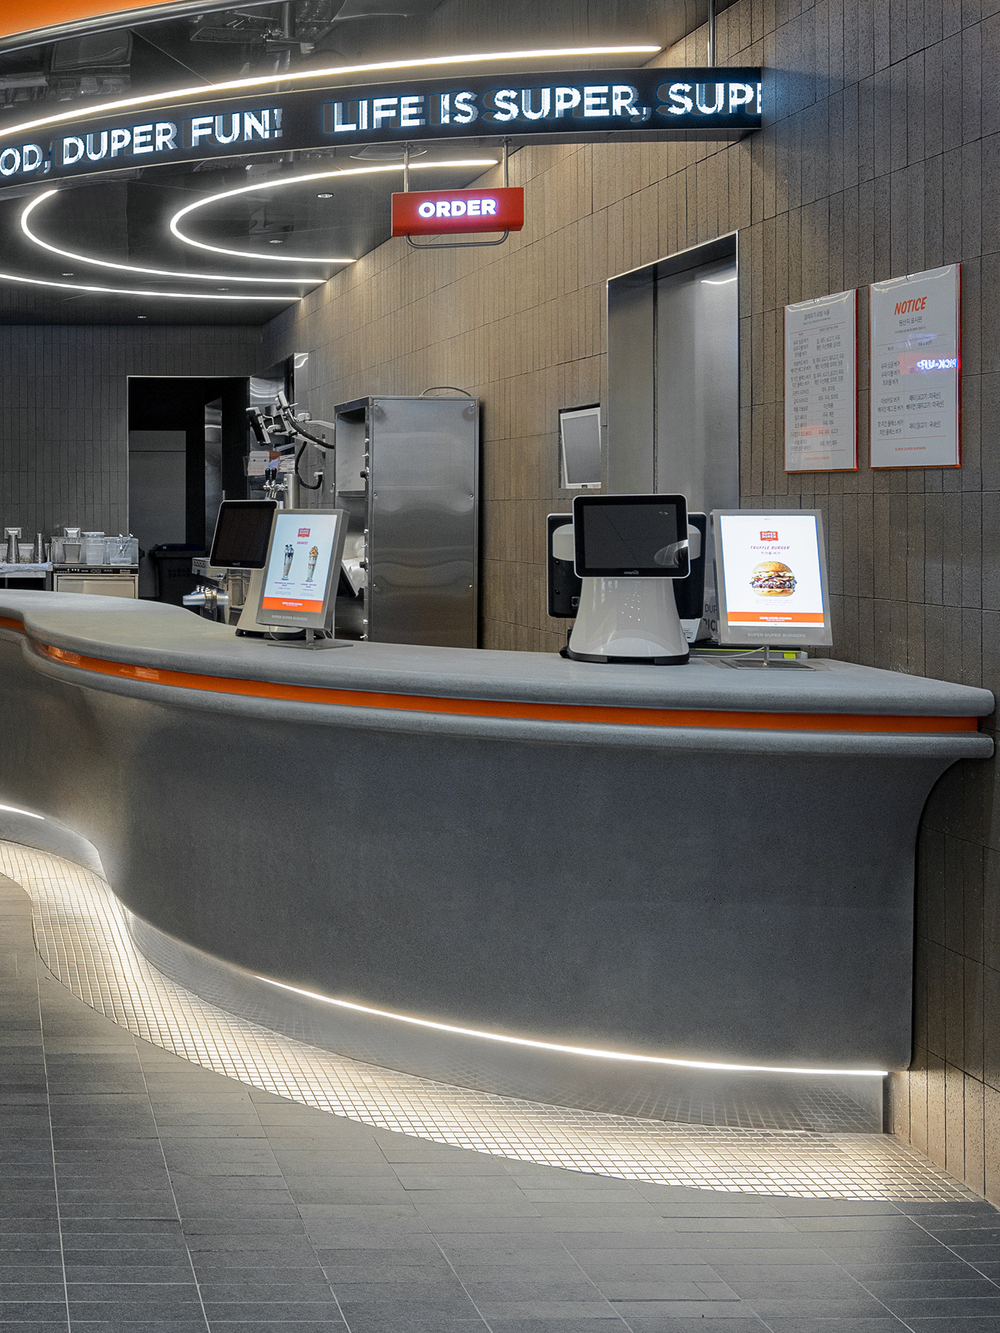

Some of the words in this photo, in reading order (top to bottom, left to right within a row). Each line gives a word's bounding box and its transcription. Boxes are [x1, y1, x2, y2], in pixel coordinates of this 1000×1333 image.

[332, 95, 425, 132] LIFE
[440, 90, 477, 124] IS
[493, 84, 651, 123] SUPER,
[667, 82, 762, 115] SUP
[63, 121, 177, 165] DUPER
[190, 108, 283, 147] FUN!
[418, 199, 498, 219] ORDER
[894, 296, 928, 316] NOTICE
